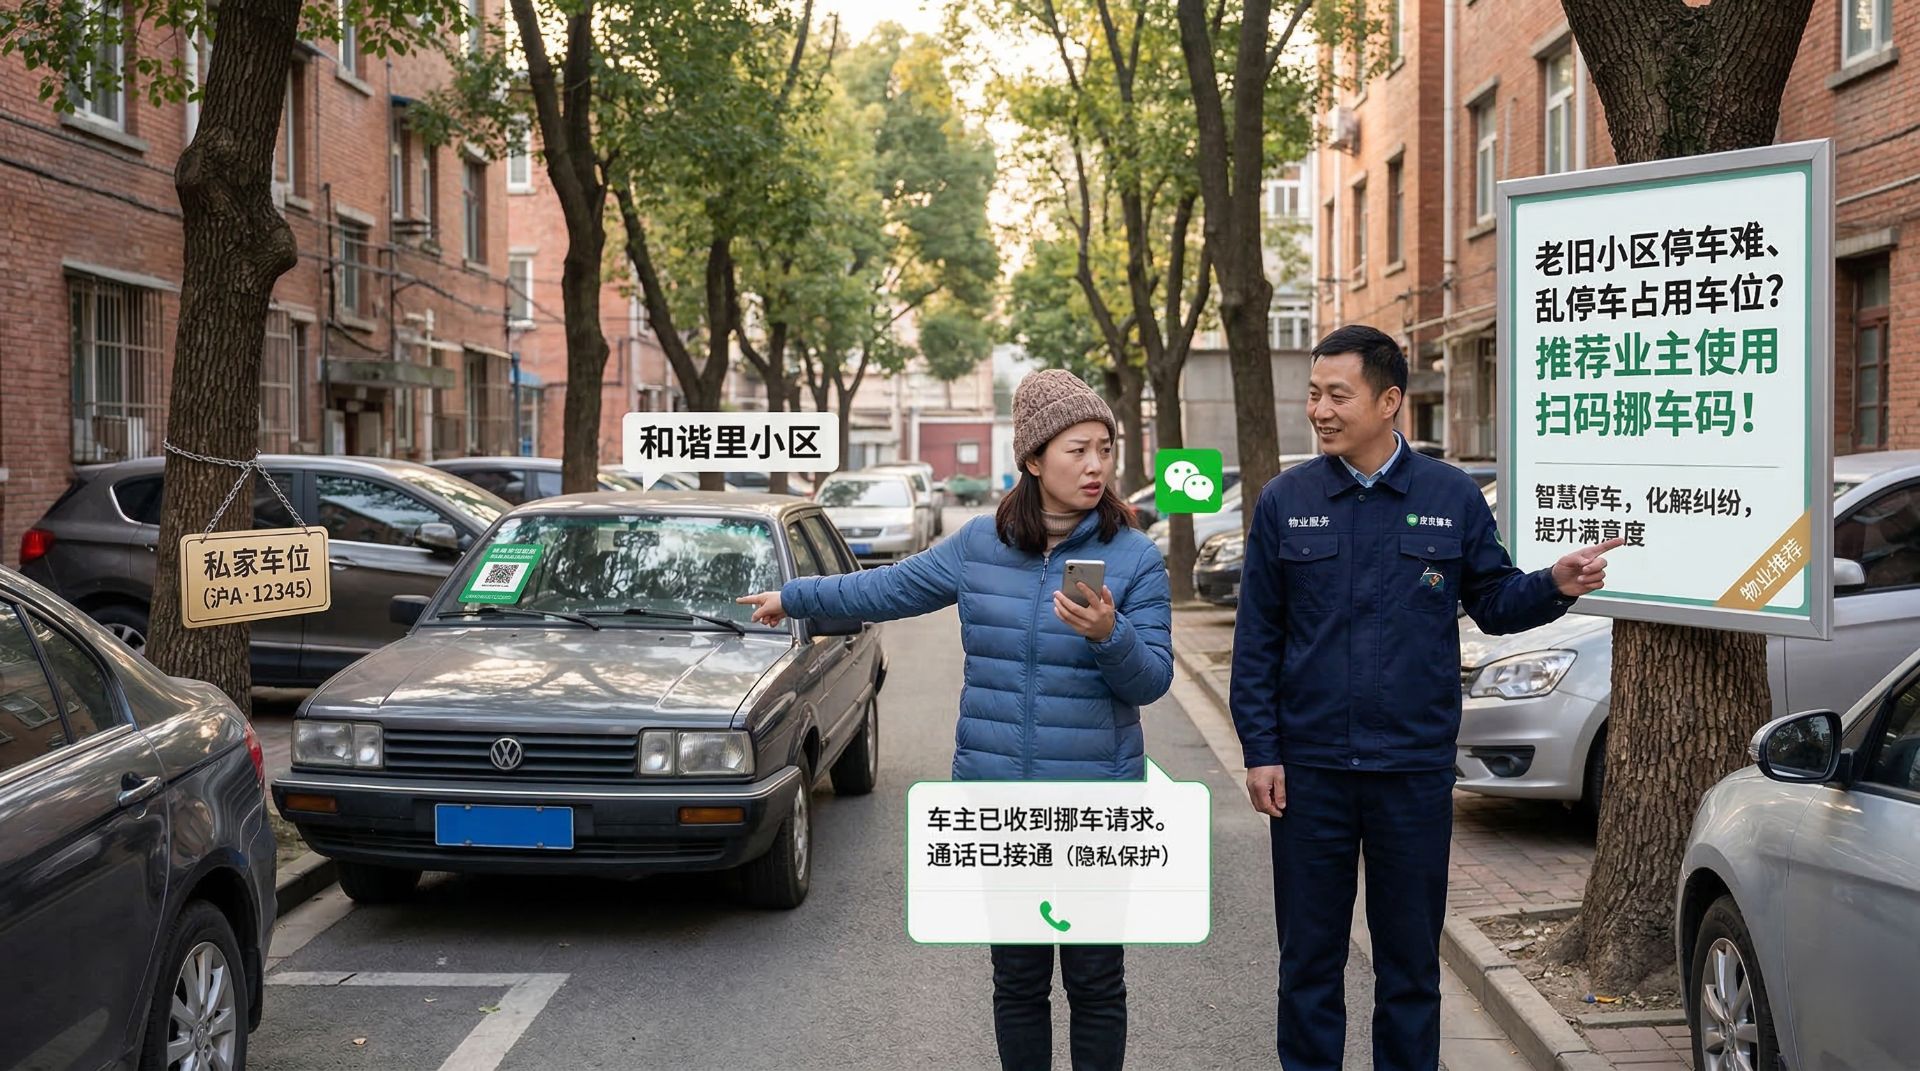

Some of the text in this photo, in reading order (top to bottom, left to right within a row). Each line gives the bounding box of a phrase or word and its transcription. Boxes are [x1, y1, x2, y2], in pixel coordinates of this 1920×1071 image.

[1535, 221, 1779, 276] 老旧小区停车难、
[1535, 328, 1778, 380] 推荐业主使用
[1535, 389, 1754, 437] 扫码挪车码！
[1288, 516, 1330, 528] 物业服务
[1534, 484, 1753, 518] 智慧停车，化解纠纷，
[1534, 518, 1646, 547] 提升满意度
[204, 544, 311, 581] 私家车位
[1740, 538, 1803, 603] 物业推荐
